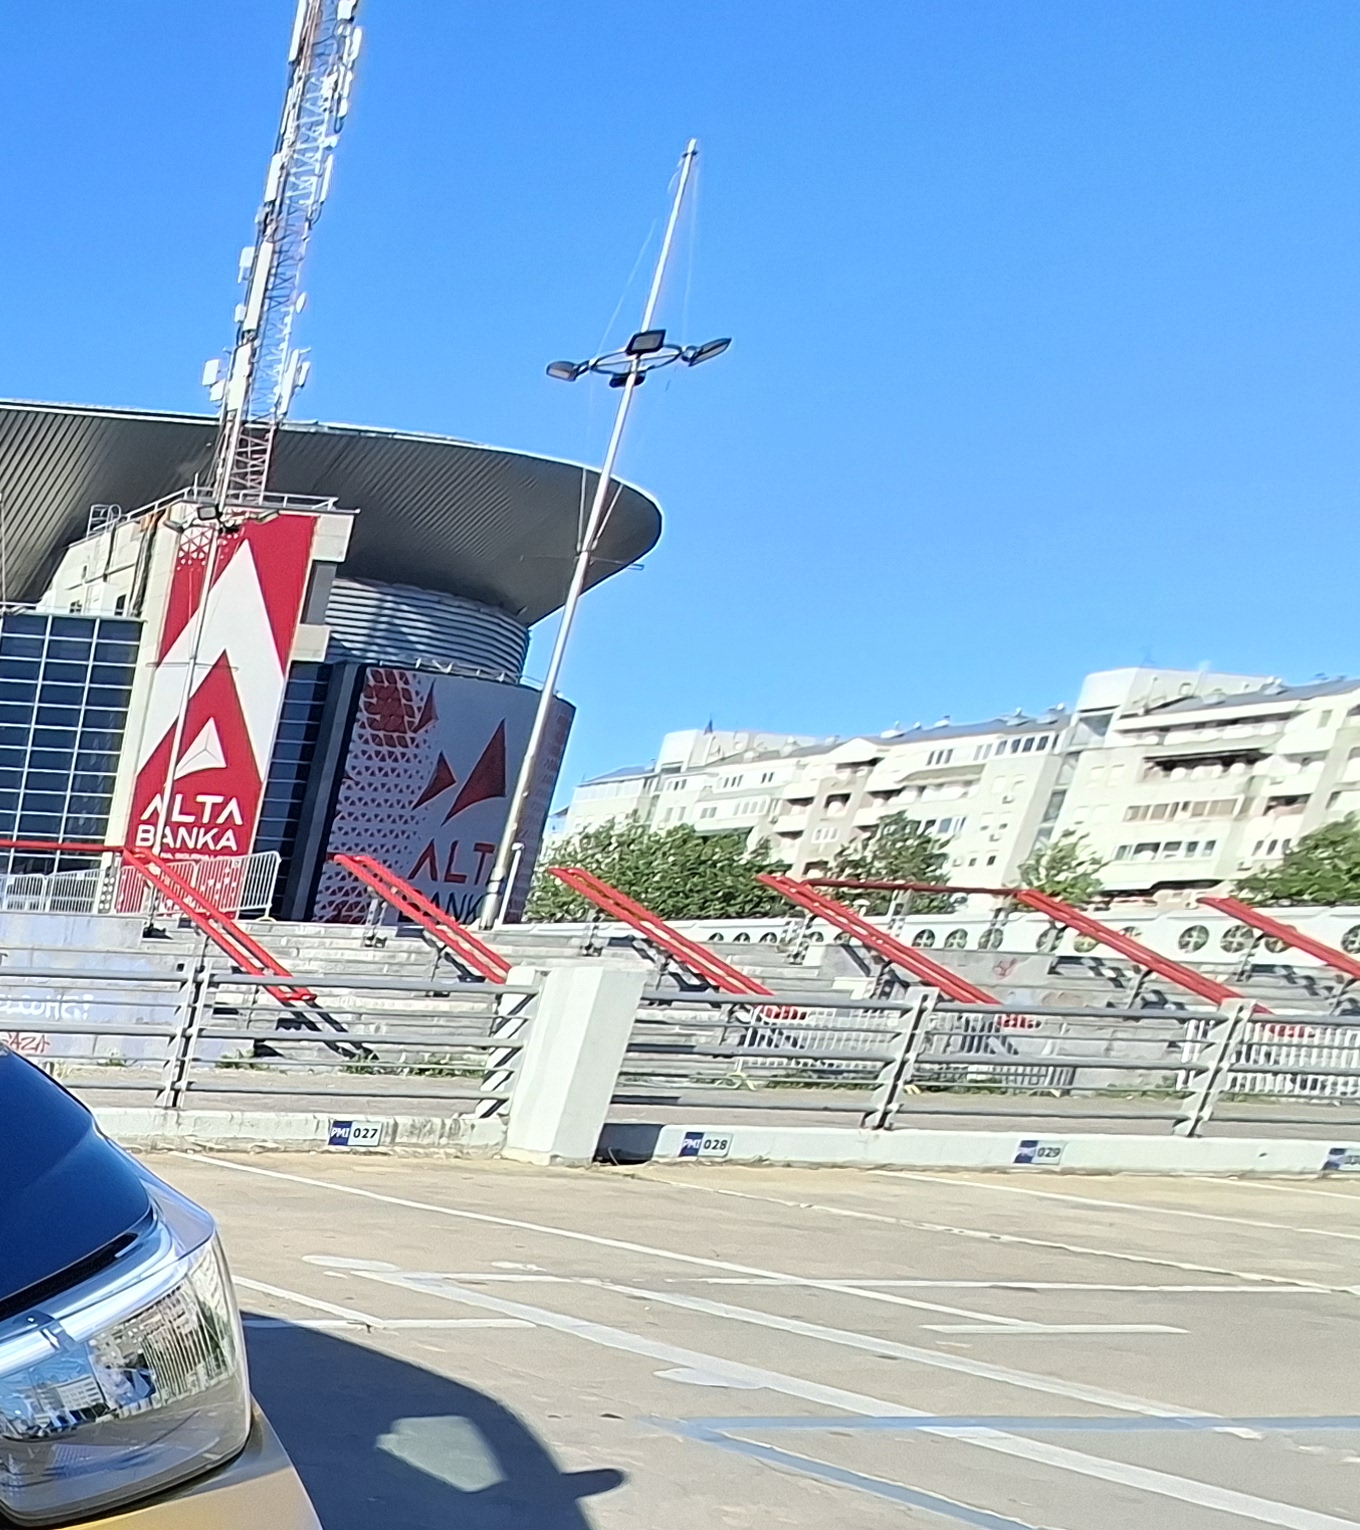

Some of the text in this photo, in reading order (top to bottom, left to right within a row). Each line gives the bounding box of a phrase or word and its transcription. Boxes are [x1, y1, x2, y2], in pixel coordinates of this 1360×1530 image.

[140, 793, 243, 825] ALTA
[135, 824, 237, 851] BANKA
[407, 838, 496, 886] ALT
[353, 1127, 378, 1139] 027
[703, 1139, 728, 1150] 028
